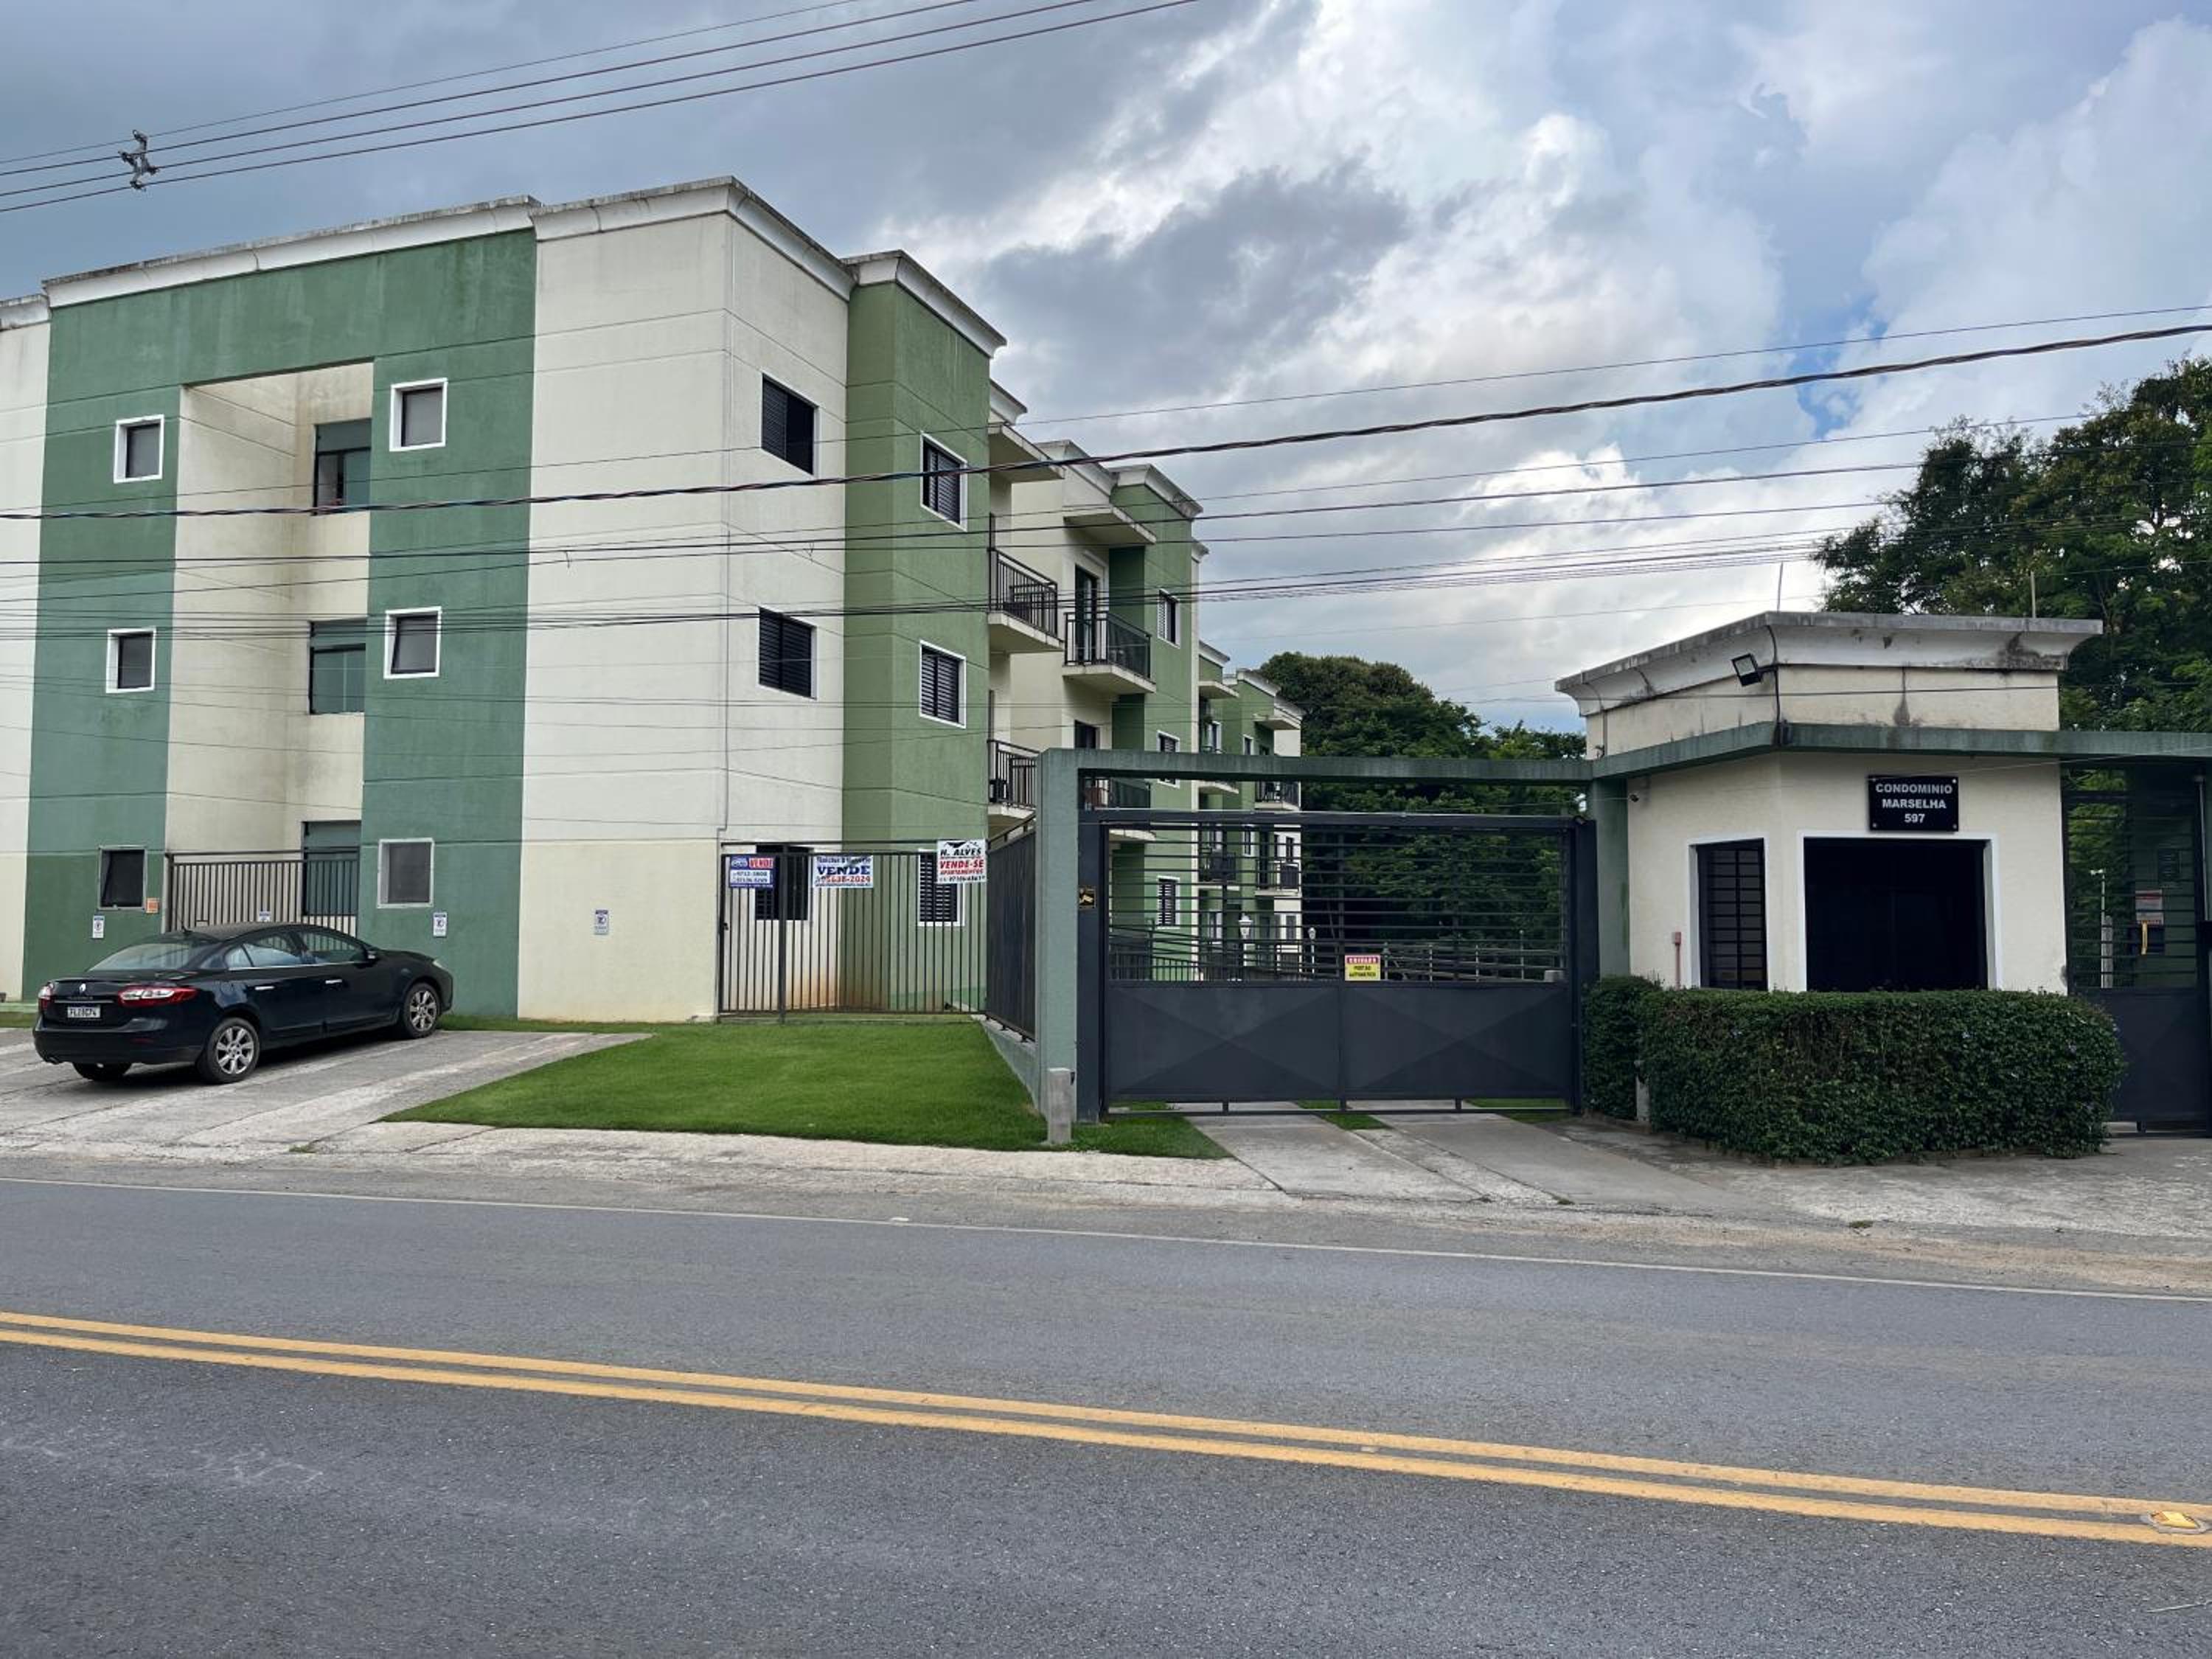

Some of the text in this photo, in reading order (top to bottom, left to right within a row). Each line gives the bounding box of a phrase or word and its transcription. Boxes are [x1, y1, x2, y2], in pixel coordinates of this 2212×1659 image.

[1876, 783, 1952, 794] CONDOMINIO
[1882, 799, 1947, 809] MARSELHA
[1904, 814, 1925, 823] 597
[940, 859, 984, 869] VENDE-SE
[817, 866, 871, 875] VENDE
